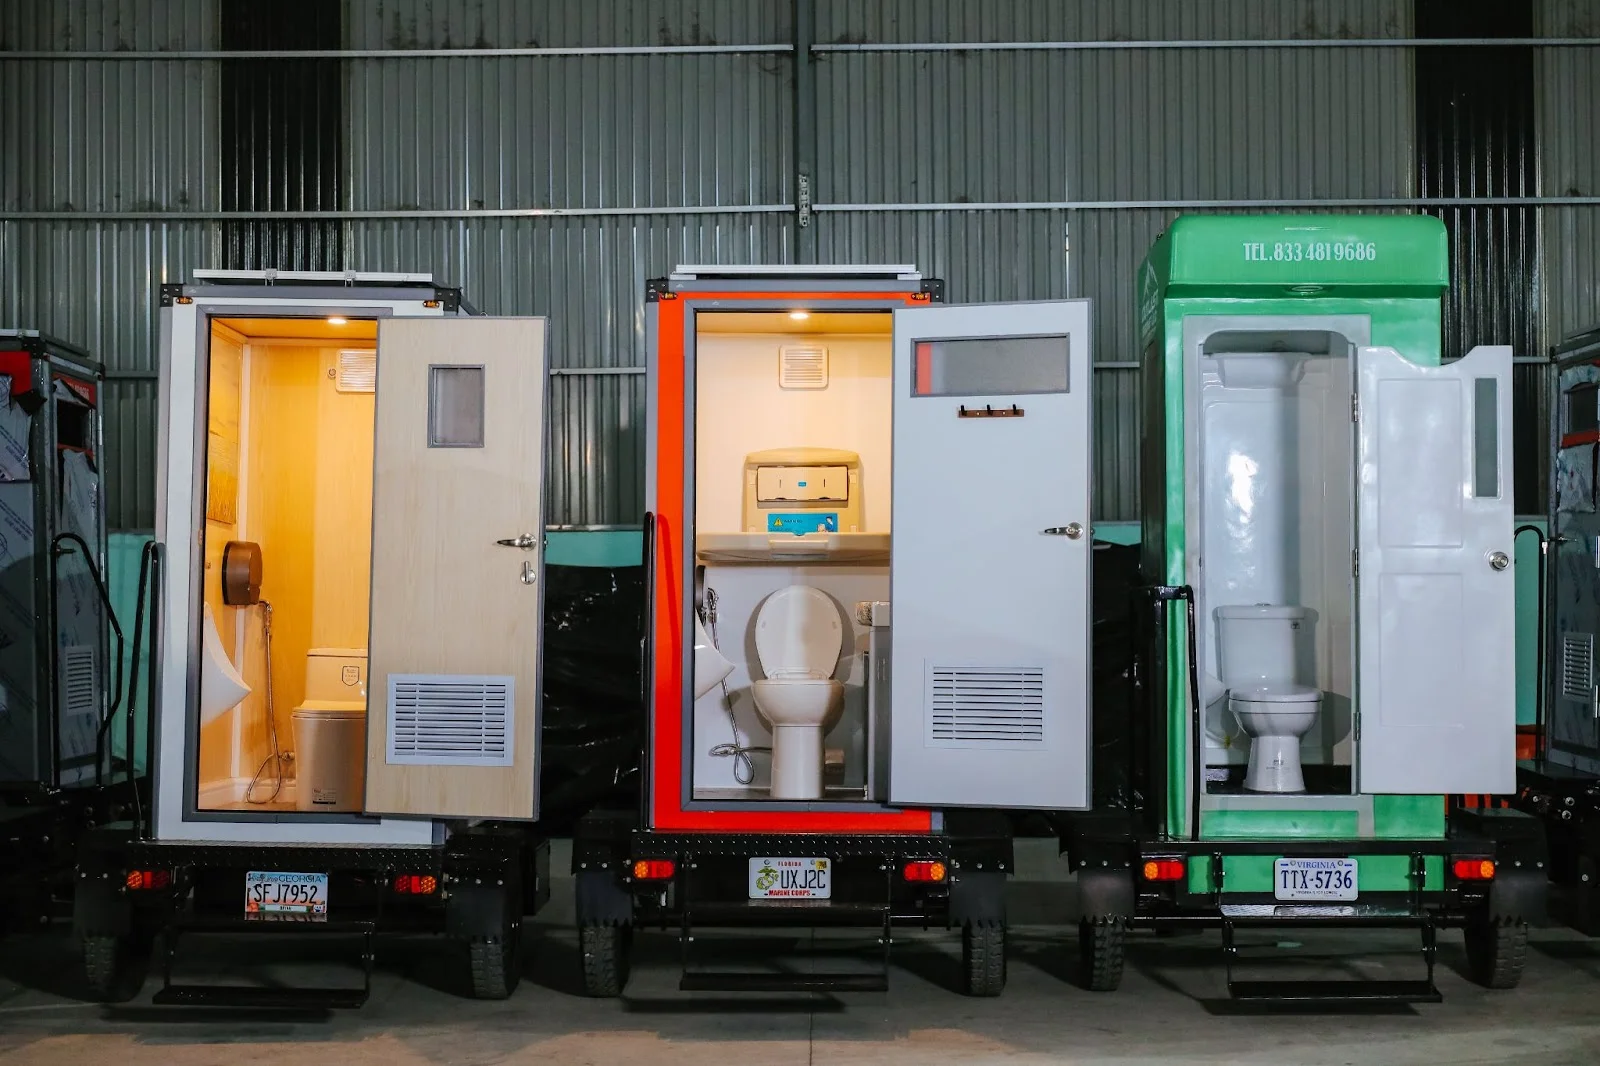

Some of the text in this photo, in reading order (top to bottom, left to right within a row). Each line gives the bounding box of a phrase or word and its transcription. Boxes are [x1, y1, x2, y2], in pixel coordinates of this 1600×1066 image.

[1333, 242, 1377, 261] 9686
[1296, 861, 1336, 869] VIRGINIA
[278, 874, 322, 883] GEORGIA
[780, 869, 826, 889] UXJ2C
[1280, 870, 1353, 889] TTX-5736
[253, 883, 318, 904] SFJ7952
